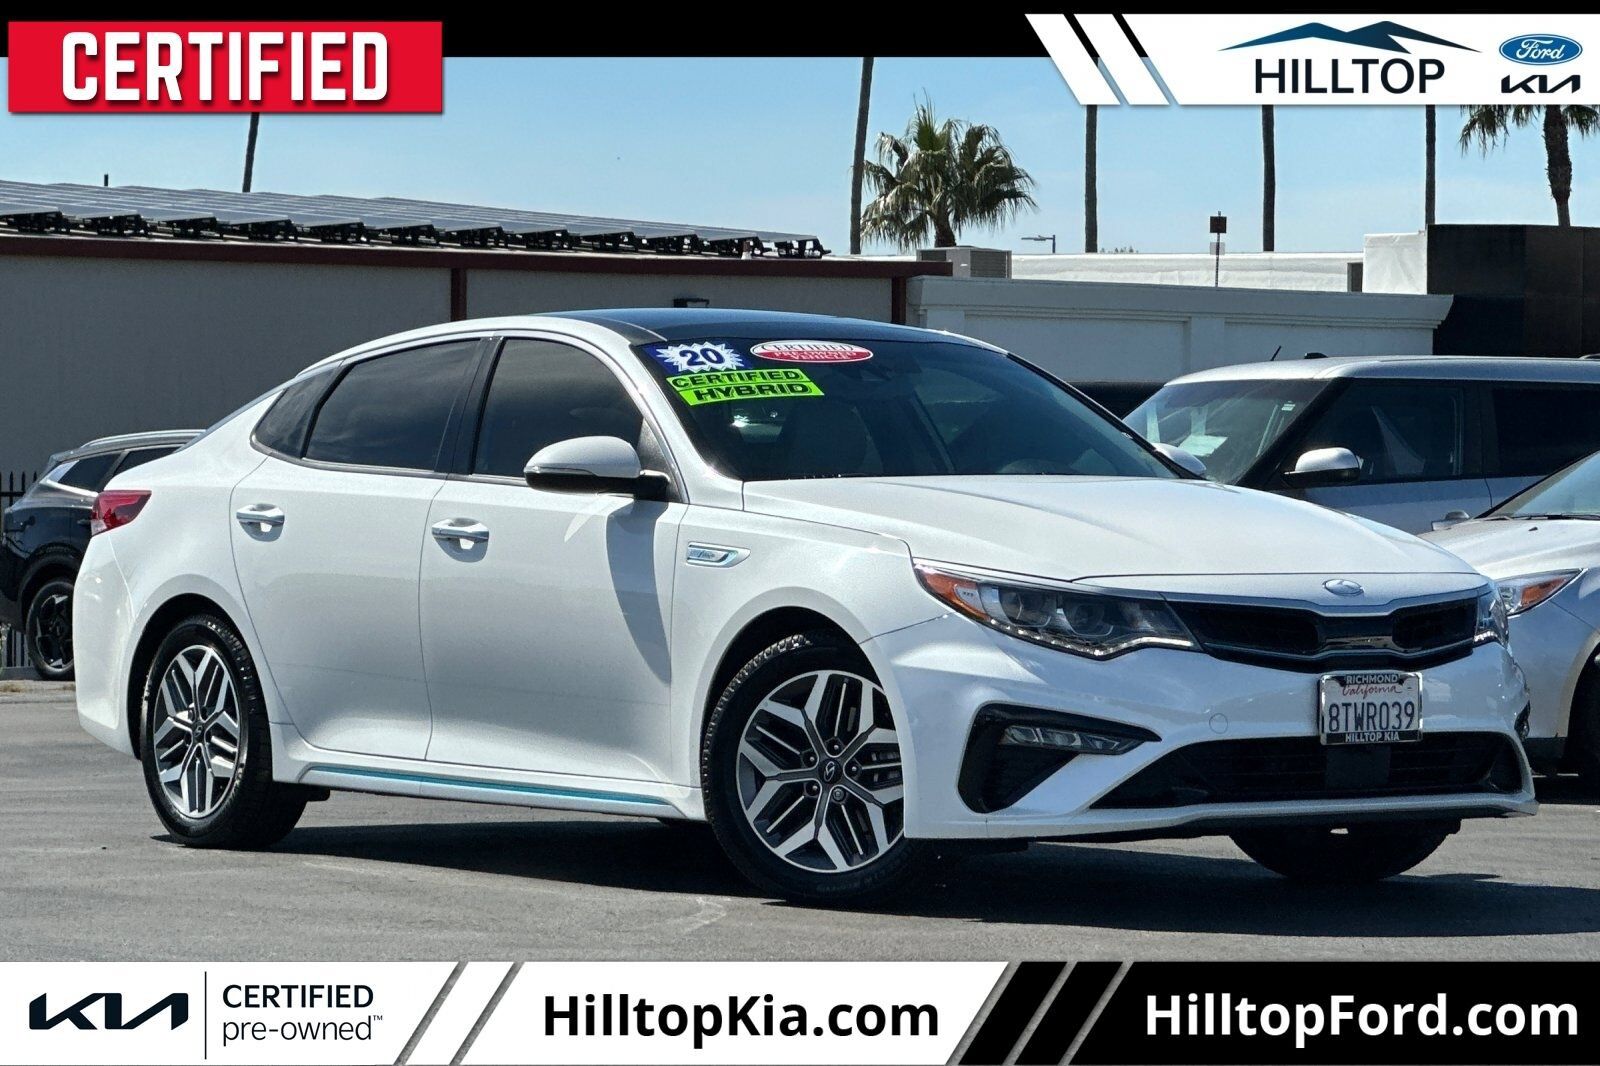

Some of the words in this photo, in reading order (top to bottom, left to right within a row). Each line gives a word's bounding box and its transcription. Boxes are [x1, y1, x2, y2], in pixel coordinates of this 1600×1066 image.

[678, 347, 725, 367] 20
[672, 370, 801, 388] CERTIFIED
[696, 382, 812, 400] HYBRID
[1346, 675, 1399, 684] RICHMOND
[1342, 685, 1402, 699] California
[1328, 701, 1415, 732] 8TWR039
[1345, 732, 1382, 742] HILLTOP
[1384, 731, 1400, 741] KIA
